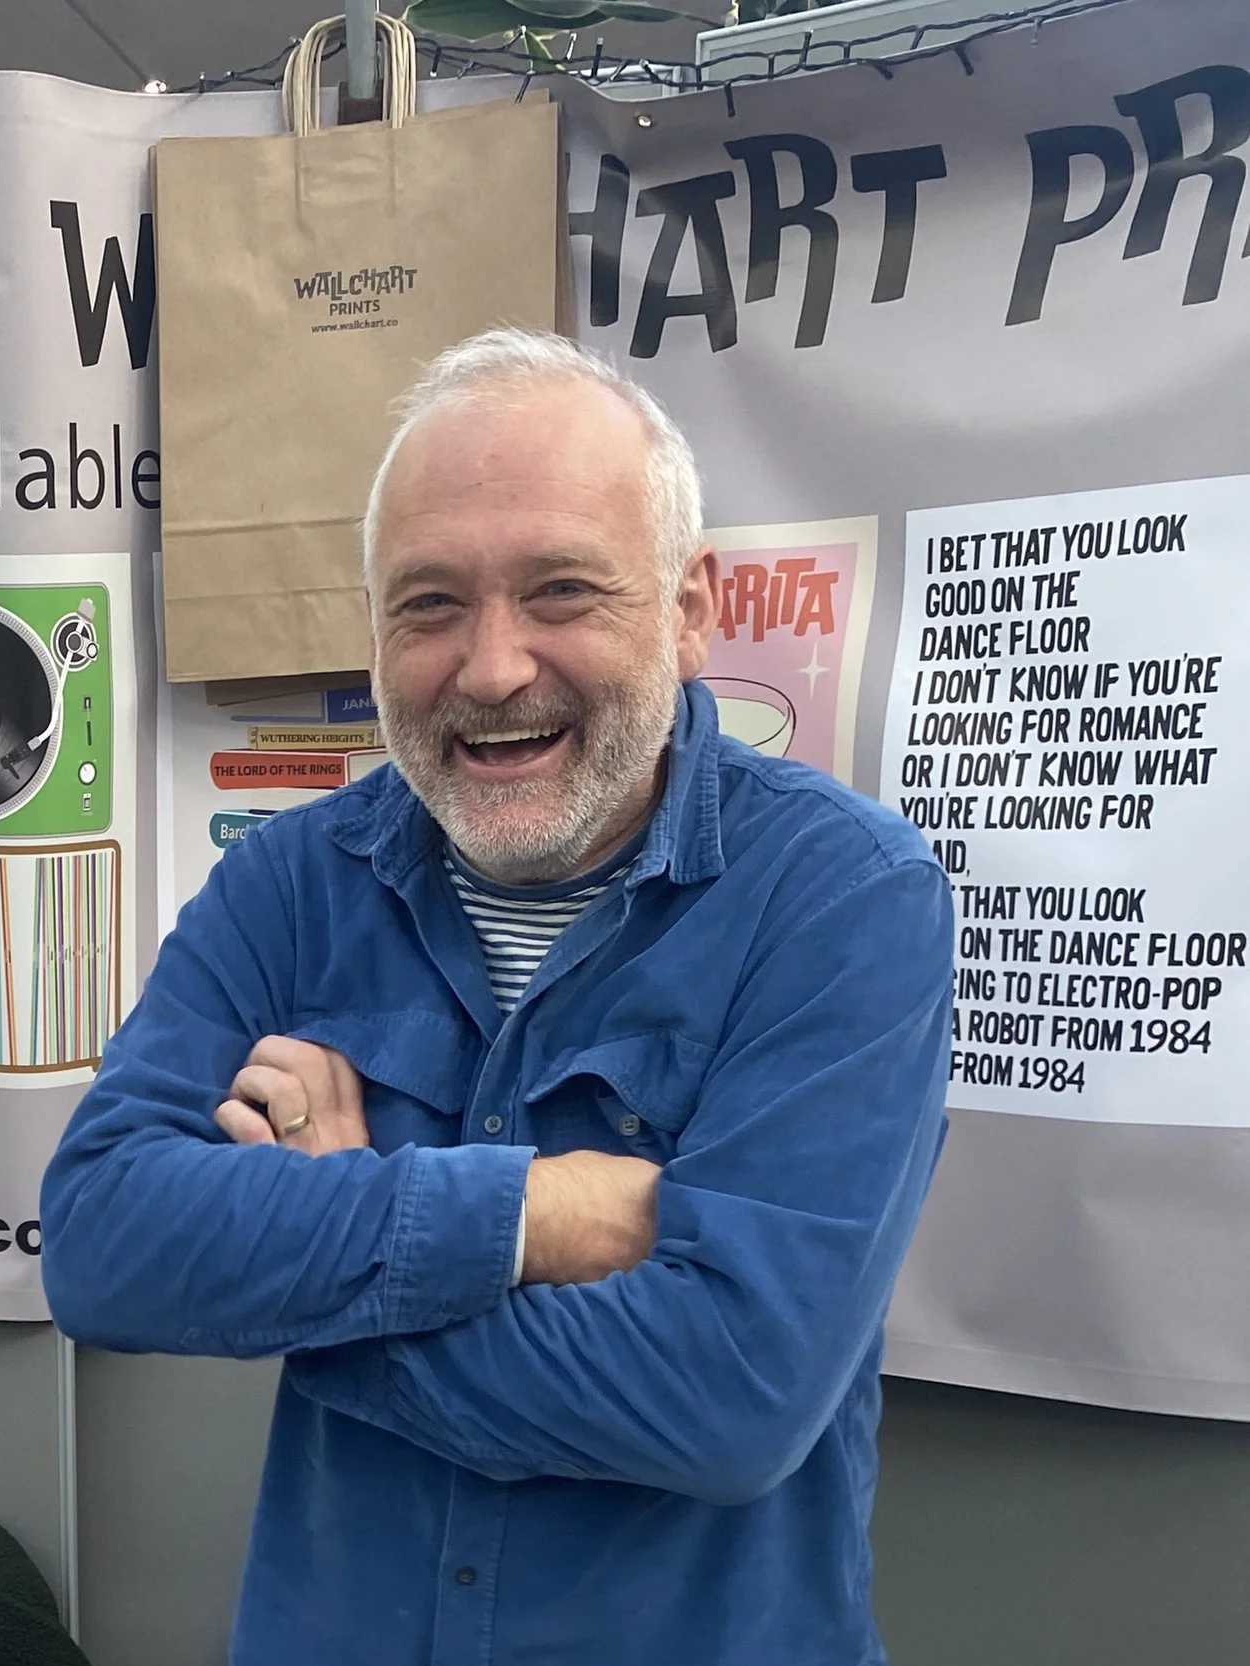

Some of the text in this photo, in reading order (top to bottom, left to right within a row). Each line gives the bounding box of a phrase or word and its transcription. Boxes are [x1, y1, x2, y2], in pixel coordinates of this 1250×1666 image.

[294, 266, 417, 300] WALLCHART
[311, 319, 398, 333] www.wallchart.co
[330, 300, 380, 316] PRINTS
[927, 514, 1188, 574] I BET THAT YOU LOOK
[926, 571, 1080, 617] GOOD ON THE
[920, 617, 1090, 661] DANCE FLOOR
[912, 653, 1222, 706] I DON'T KNOW IF YOU'RE
[260, 734, 364, 743] WUTHERING HEIGHTS
[908, 703, 1206, 746] LOOKING FOR ROMANCE
[215, 763, 342, 776] THE LORD OF THE RINGS
[901, 748, 1217, 787] OR I DON'T KNOW WHAT
[901, 792, 1154, 830] YOU'RE LOOKING FOR
[960, 886, 1146, 922] THAT YOU LOOK
[960, 927, 1247, 967] ON THE DANCE FLOOR
[1003, 971, 1222, 1010] TO ELECTRO-POP
[968, 1010, 1211, 1054] ROBOT FROM 1984
[951, 1051, 1084, 1093] FROM 1984
